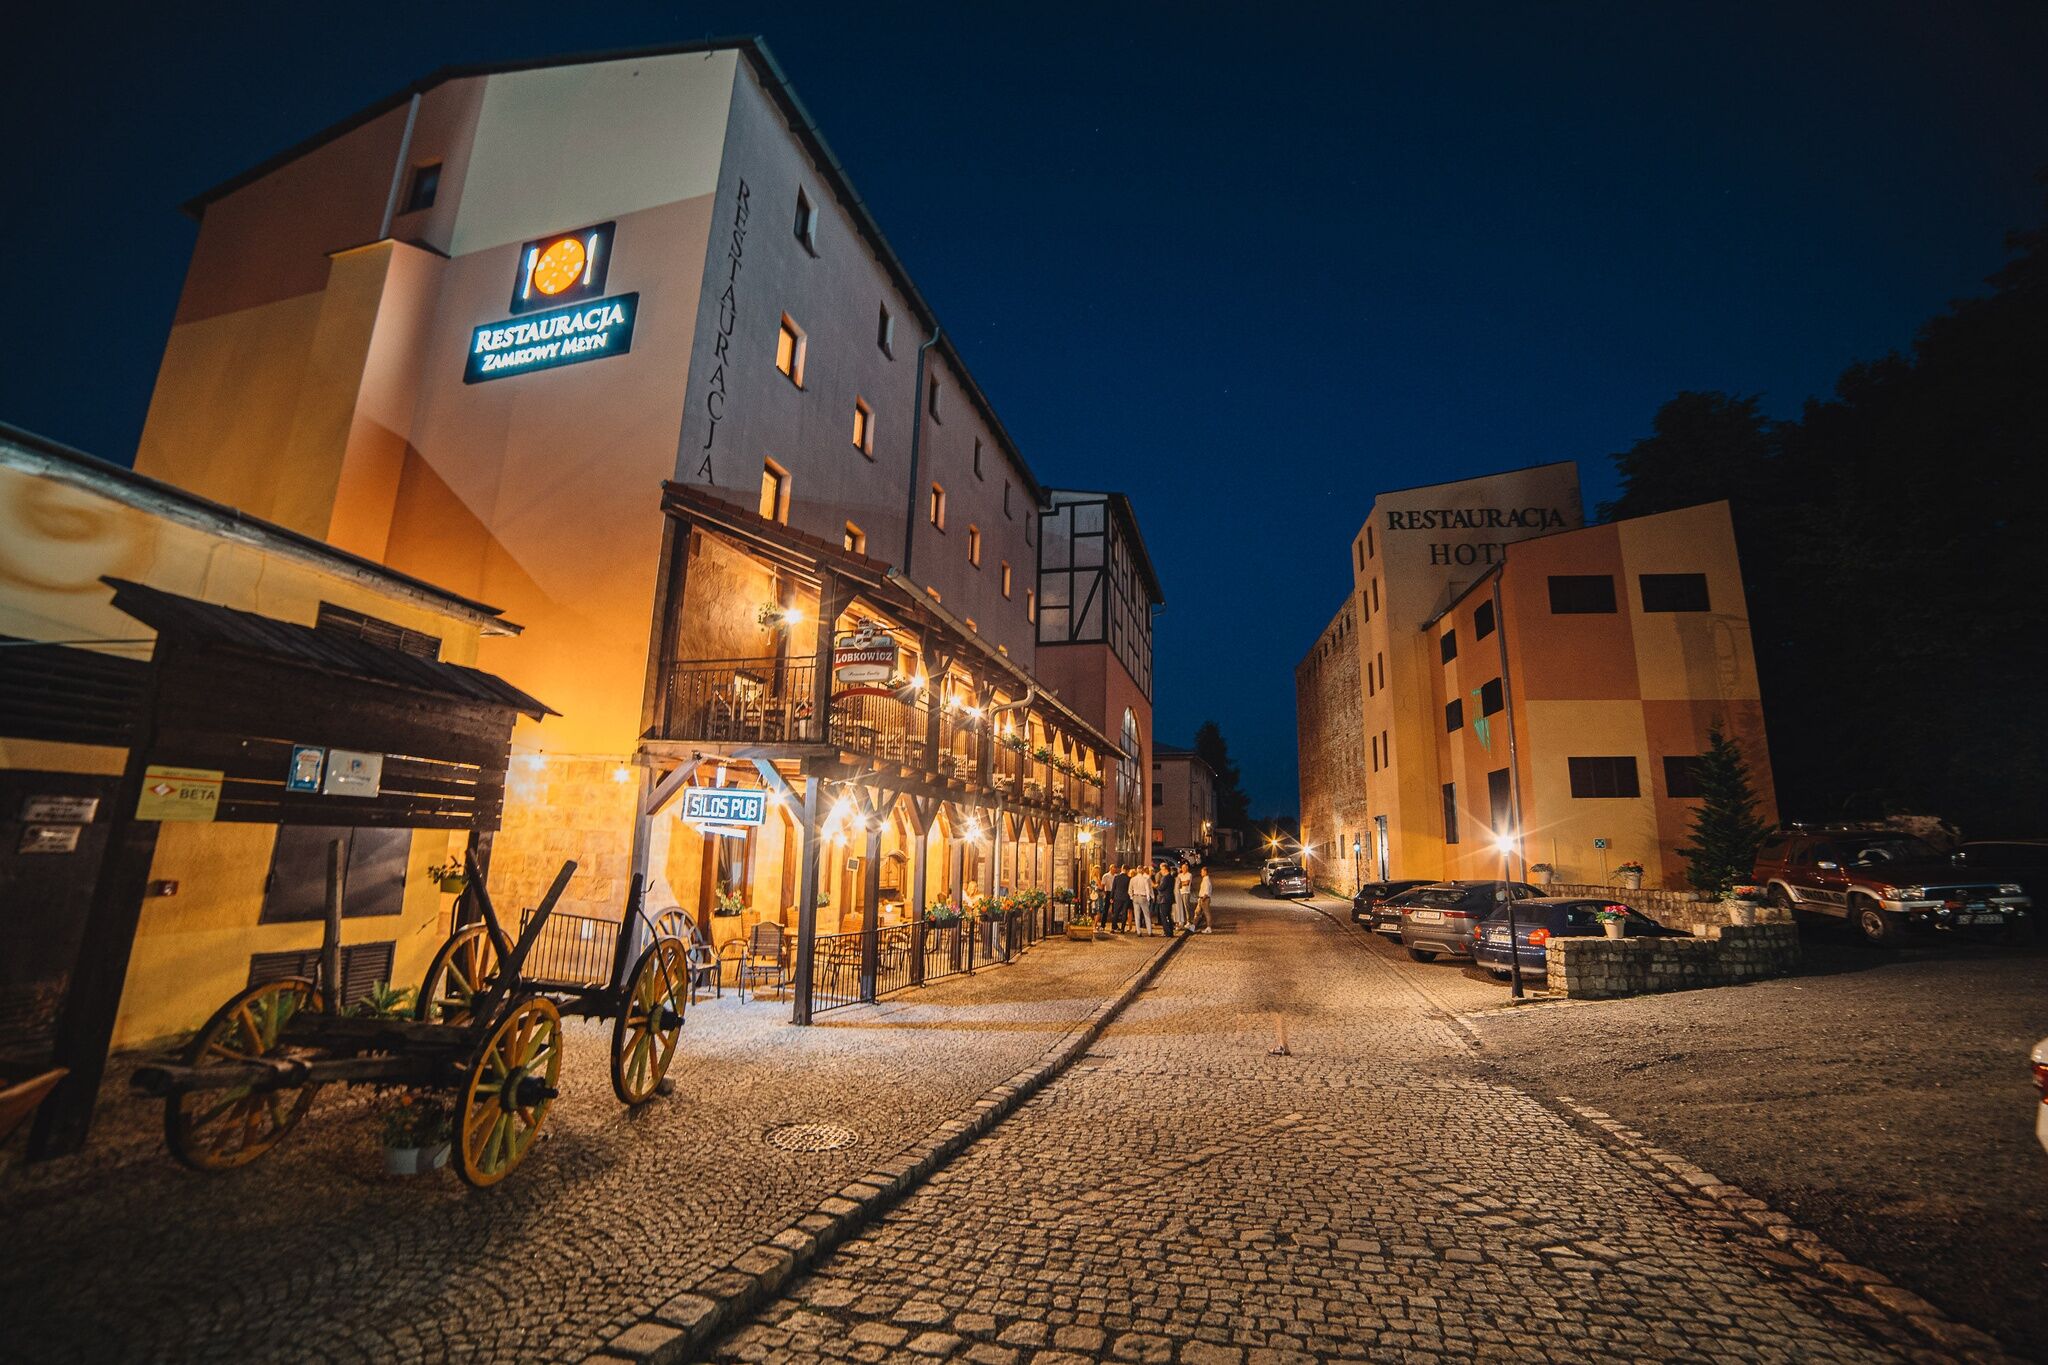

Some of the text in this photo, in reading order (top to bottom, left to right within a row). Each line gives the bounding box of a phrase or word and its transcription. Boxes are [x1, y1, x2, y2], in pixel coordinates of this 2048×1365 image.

[475, 304, 625, 353] RESTAURACJA
[697, 177, 751, 486] RESTAURACJA
[482, 333, 608, 372] ZAMKOWY MŁYN
[1387, 507, 1567, 531] RESTAURACJA
[835, 652, 893, 664] LOBKOWICZ
[180, 788, 216, 800] BETA
[690, 797, 758, 819] SILOS PUB
